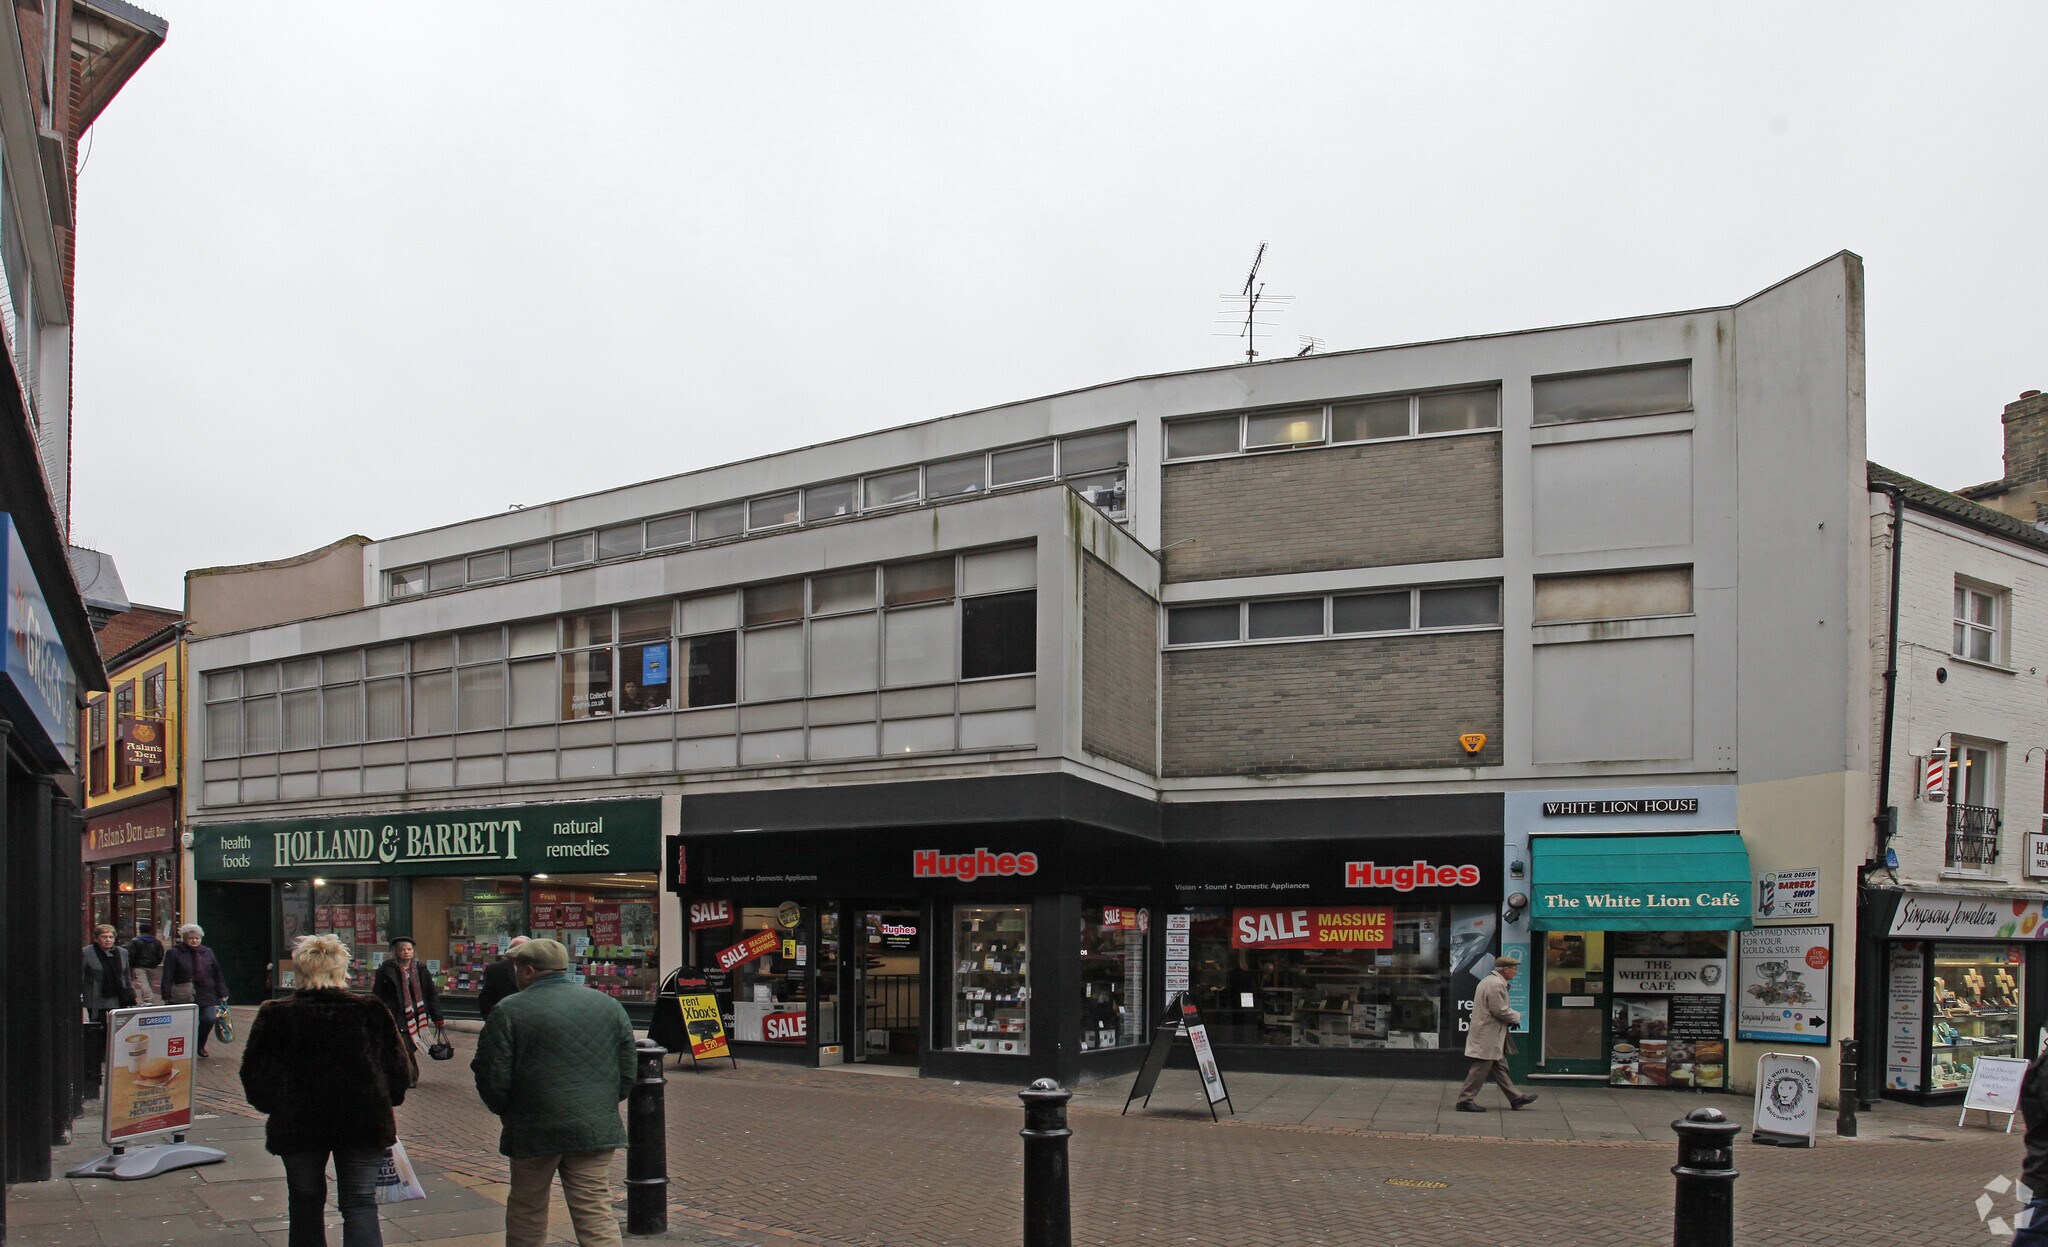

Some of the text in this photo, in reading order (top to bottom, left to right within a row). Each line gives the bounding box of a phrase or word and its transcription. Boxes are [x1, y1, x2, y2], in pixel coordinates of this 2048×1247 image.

[27, 605, 62, 725] GREGGS
[590, 691, 606, 700] Collect
[127, 742, 162, 752] Aslan's
[134, 750, 156, 759] Den
[1546, 799, 1697, 815] WHITE LION HOUSE
[553, 816, 602, 835] natural
[98, 822, 166, 850] Aslan's Den Café Bar
[221, 835, 251, 850] health
[273, 820, 522, 867] HOLLAND & BARRETT
[546, 840, 610, 857] remedies
[222, 854, 250, 868] foods
[913, 847, 1038, 882] Hughes
[785, 874, 818, 882] Appliances
[1345, 860, 1480, 892] Hughes
[1270, 882, 1310, 890] Appliances
[1778, 880, 1816, 889] BARBERS
[1545, 892, 1740, 908] The White Lion Café
[1793, 890, 1815, 898] SHOP
[535, 906, 552, 914] Penny
[690, 901, 729, 923] SALE
[1897, 898, 1998, 932] Simpsons Jewellers
[594, 912, 620, 922] Penny
[1104, 909, 1120, 925] SALE
[1318, 913, 1386, 926] MASSIVE
[596, 924, 613, 933] Sale
[881, 924, 916, 936] Hughes
[1238, 910, 1310, 944] SALE
[1784, 928, 1827, 936] INSTANTLY
[748, 932, 775, 948] MASSIVE
[1319, 929, 1385, 942] SAVINGS
[751, 940, 777, 955] SAVINGS
[1742, 946, 1765, 954] GOLD
[720, 943, 749, 968] SALE
[1644, 960, 1672, 970] THE
[1618, 970, 1698, 980] WHITE LION
[1639, 979, 1676, 991] CAFÉ
[682, 997, 700, 1007] rent
[1457, 1000, 1474, 1010] re
[684, 1006, 718, 1020] Xbox's
[146, 1017, 171, 1025] GREGGS
[767, 1015, 807, 1039] SALE
[703, 1039, 718, 1050] £20
[1771, 1068, 1789, 1079] WHITE
[1790, 1068, 1806, 1079] LION
[1996, 1066, 2018, 1075] Design
[133, 1096, 171, 1109] FROSTY
[129, 1104, 174, 1117] MORNINGS
[1766, 1105, 1807, 1121] Welcomes You!
